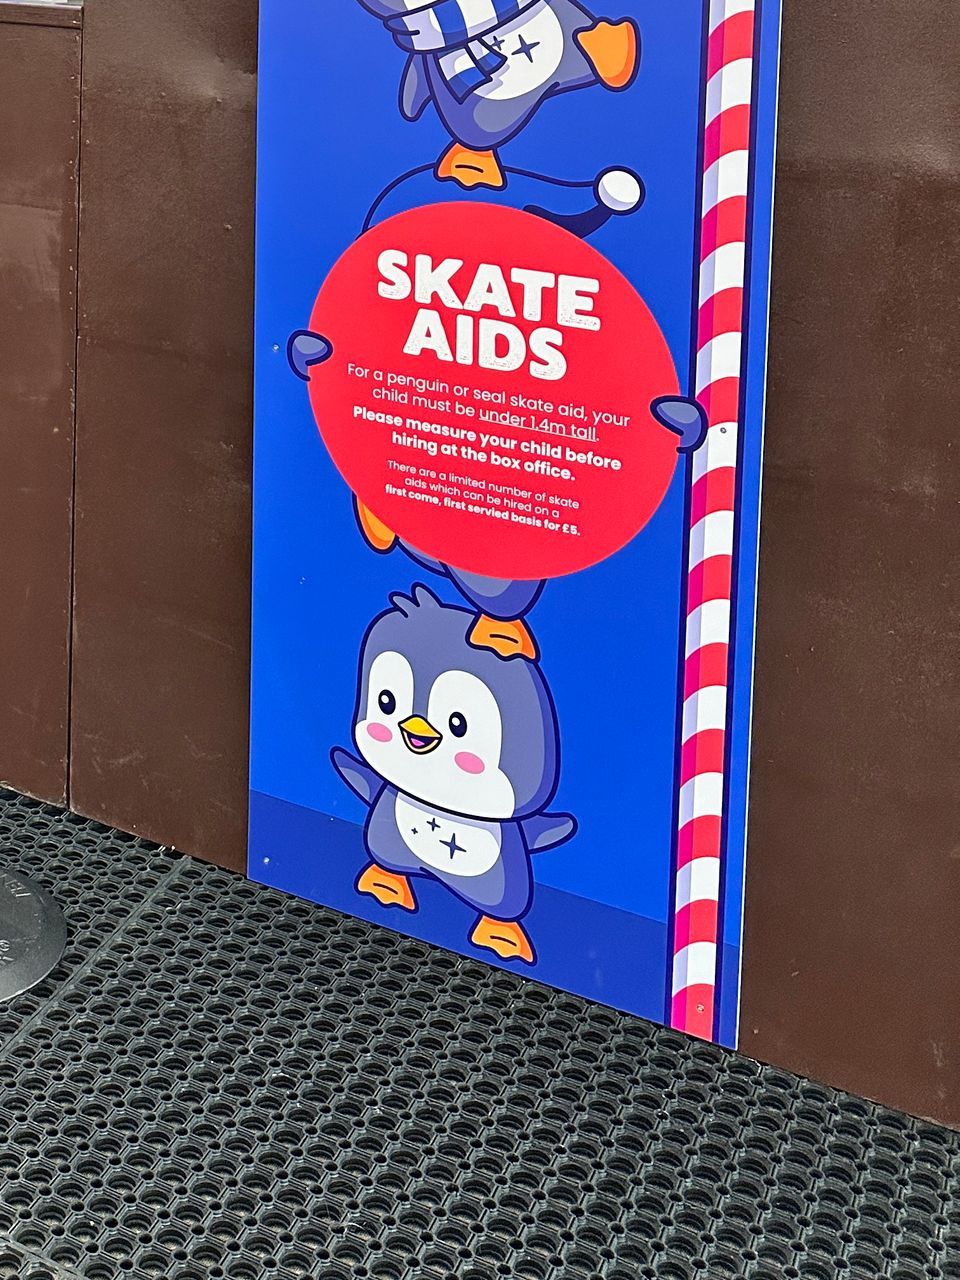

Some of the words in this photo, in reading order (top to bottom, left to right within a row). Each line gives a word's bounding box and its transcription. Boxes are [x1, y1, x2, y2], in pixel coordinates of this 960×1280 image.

[376, 248, 601, 331] SKATE
[402, 308, 567, 381] AIDS
[347, 363, 370, 378] For
[373, 370, 383, 381] a
[387, 372, 449, 393] penguin
[453, 385, 469, 397] or
[473, 389, 506, 404] seal
[510, 394, 554, 413] skate
[558, 404, 588, 421] aid,
[592, 410, 630, 427] your
[372, 386, 408, 404] child
[412, 395, 451, 413] must
[455, 401, 475, 417] be
[479, 408, 526, 427] under
[530, 415, 566, 435] 1.4m
[571, 423, 600, 442] tall.
[353, 405, 403, 427] Please
[405, 417, 477, 441] measure
[480, 432, 518, 450] your
[520, 440, 562, 460] child
[565, 447, 622, 471] before
[392, 431, 438, 456] hiring
[440, 443, 458, 457] at
[460, 445, 488, 462] the
[490, 451, 521, 470] box
[523, 459, 576, 481] office.
[385, 483, 407, 497] first
[408, 491, 442, 507] come,
[443, 497, 467, 511] first
[467, 503, 509, 520] servied
[511, 512, 542, 528] basis
[543, 519, 561, 532] for
[562, 523, 581, 537] £5.
[387, 459, 417, 474] There
[418, 468, 437, 479] are
[439, 472, 447, 481] a
[449, 472, 486, 489] limited
[488, 482, 532, 499] number
[534, 492, 547, 502] of
[548, 495, 580, 509] skate
[404, 477, 427, 489] aids
[429, 482, 461, 497] which
[463, 490, 485, 502] can
[486, 494, 501, 505] be
[503, 497, 532, 512] hired
[534, 506, 549, 516] on
[551, 510, 560, 518] a
